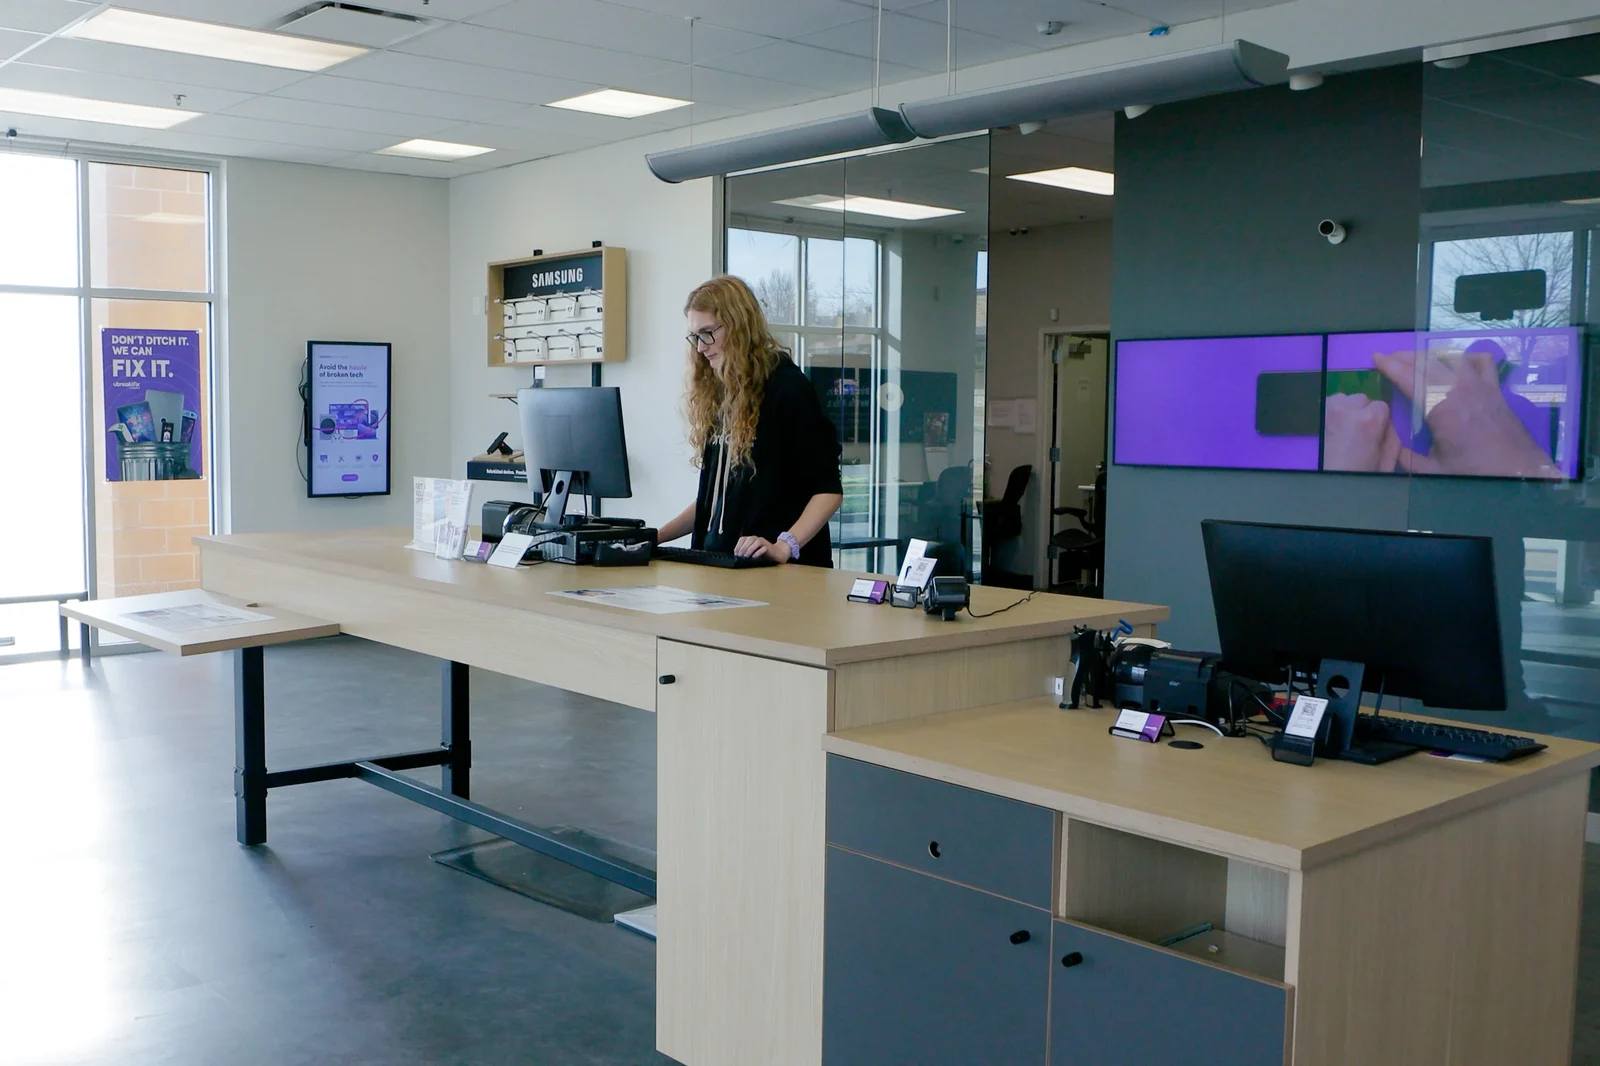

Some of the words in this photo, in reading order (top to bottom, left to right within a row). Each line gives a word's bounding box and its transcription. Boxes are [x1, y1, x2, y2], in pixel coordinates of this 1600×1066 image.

[532, 268, 583, 288] SAMSUNG
[111, 335, 144, 345] DON'T
[146, 335, 176, 345] DITCH
[178, 337, 189, 346] IT.
[112, 346, 129, 355] WE
[131, 346, 152, 355] CAN
[112, 359, 146, 378] FIX
[151, 359, 174, 378] IT.
